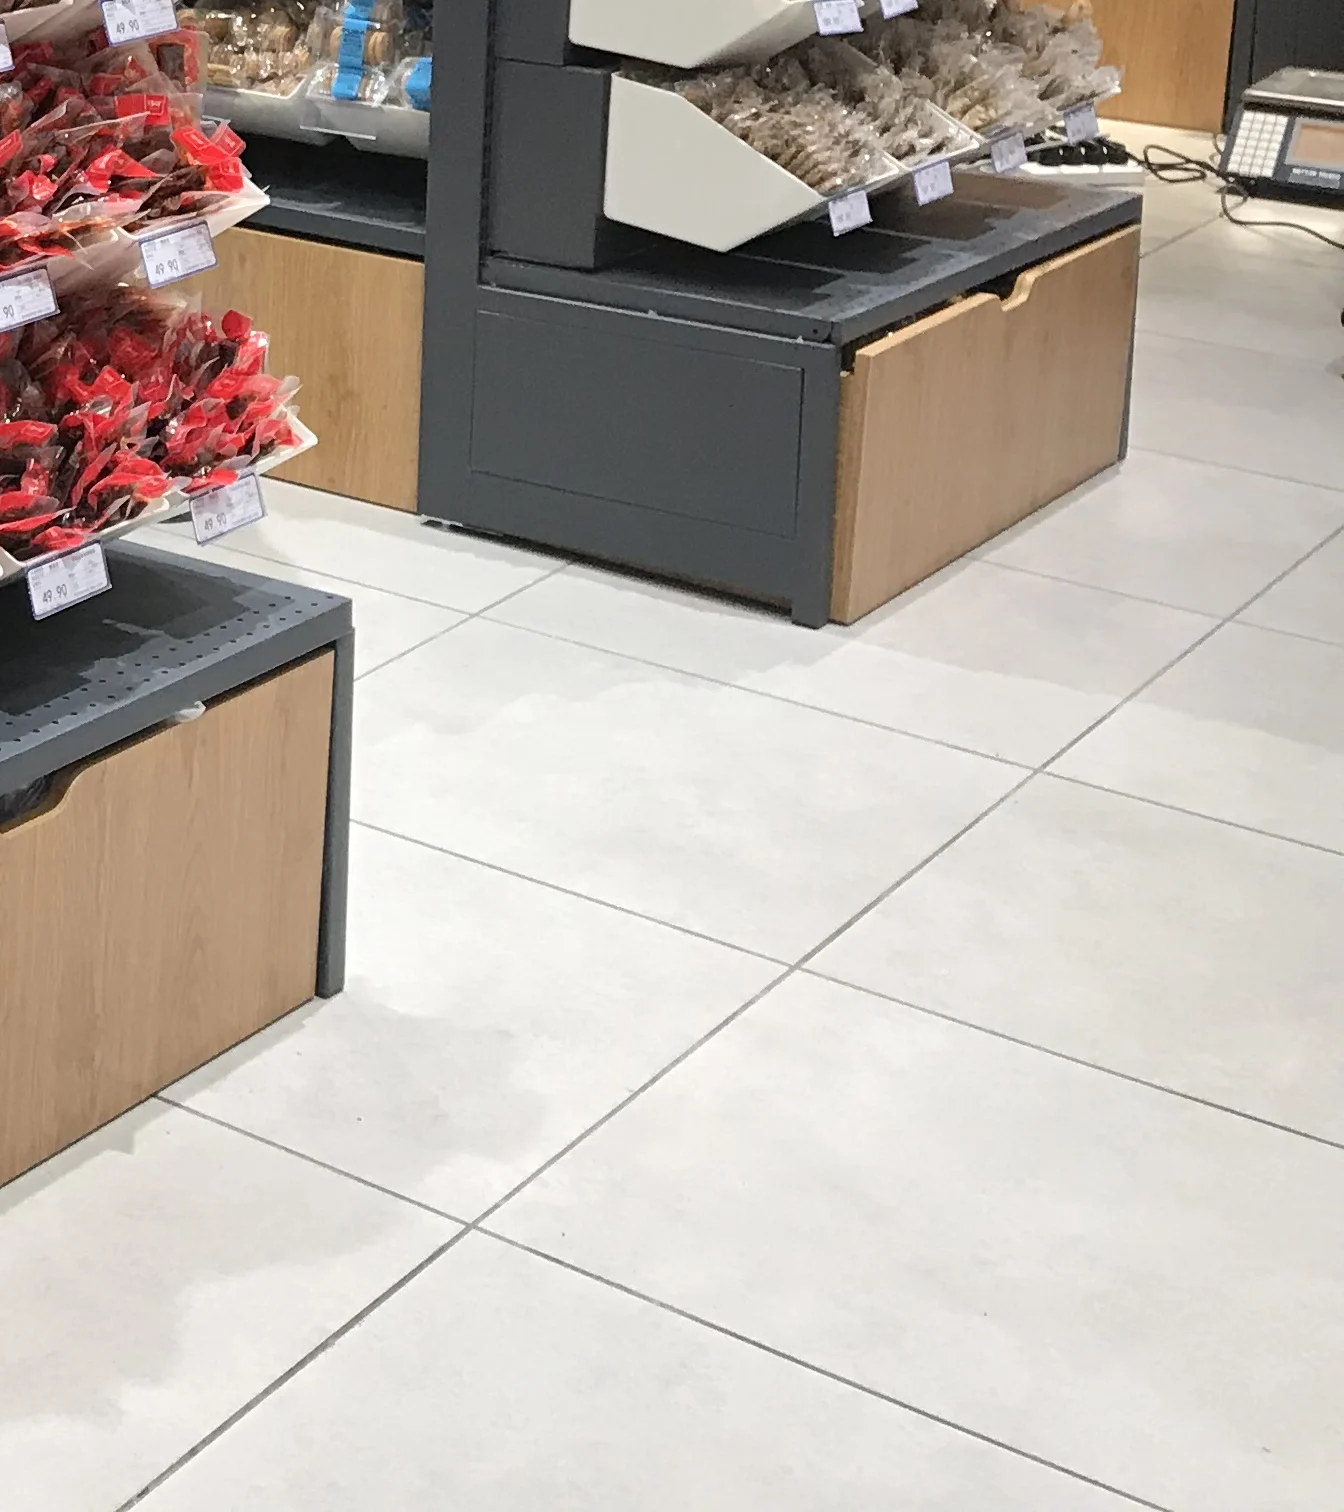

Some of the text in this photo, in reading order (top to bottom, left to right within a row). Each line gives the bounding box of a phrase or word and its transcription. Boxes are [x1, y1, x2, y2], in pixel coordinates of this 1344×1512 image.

[116, 19, 139, 34] 49.90
[155, 259, 179, 275] 49.90
[204, 513, 228, 531] 49.90
[42, 584, 68, 602] 49.90
